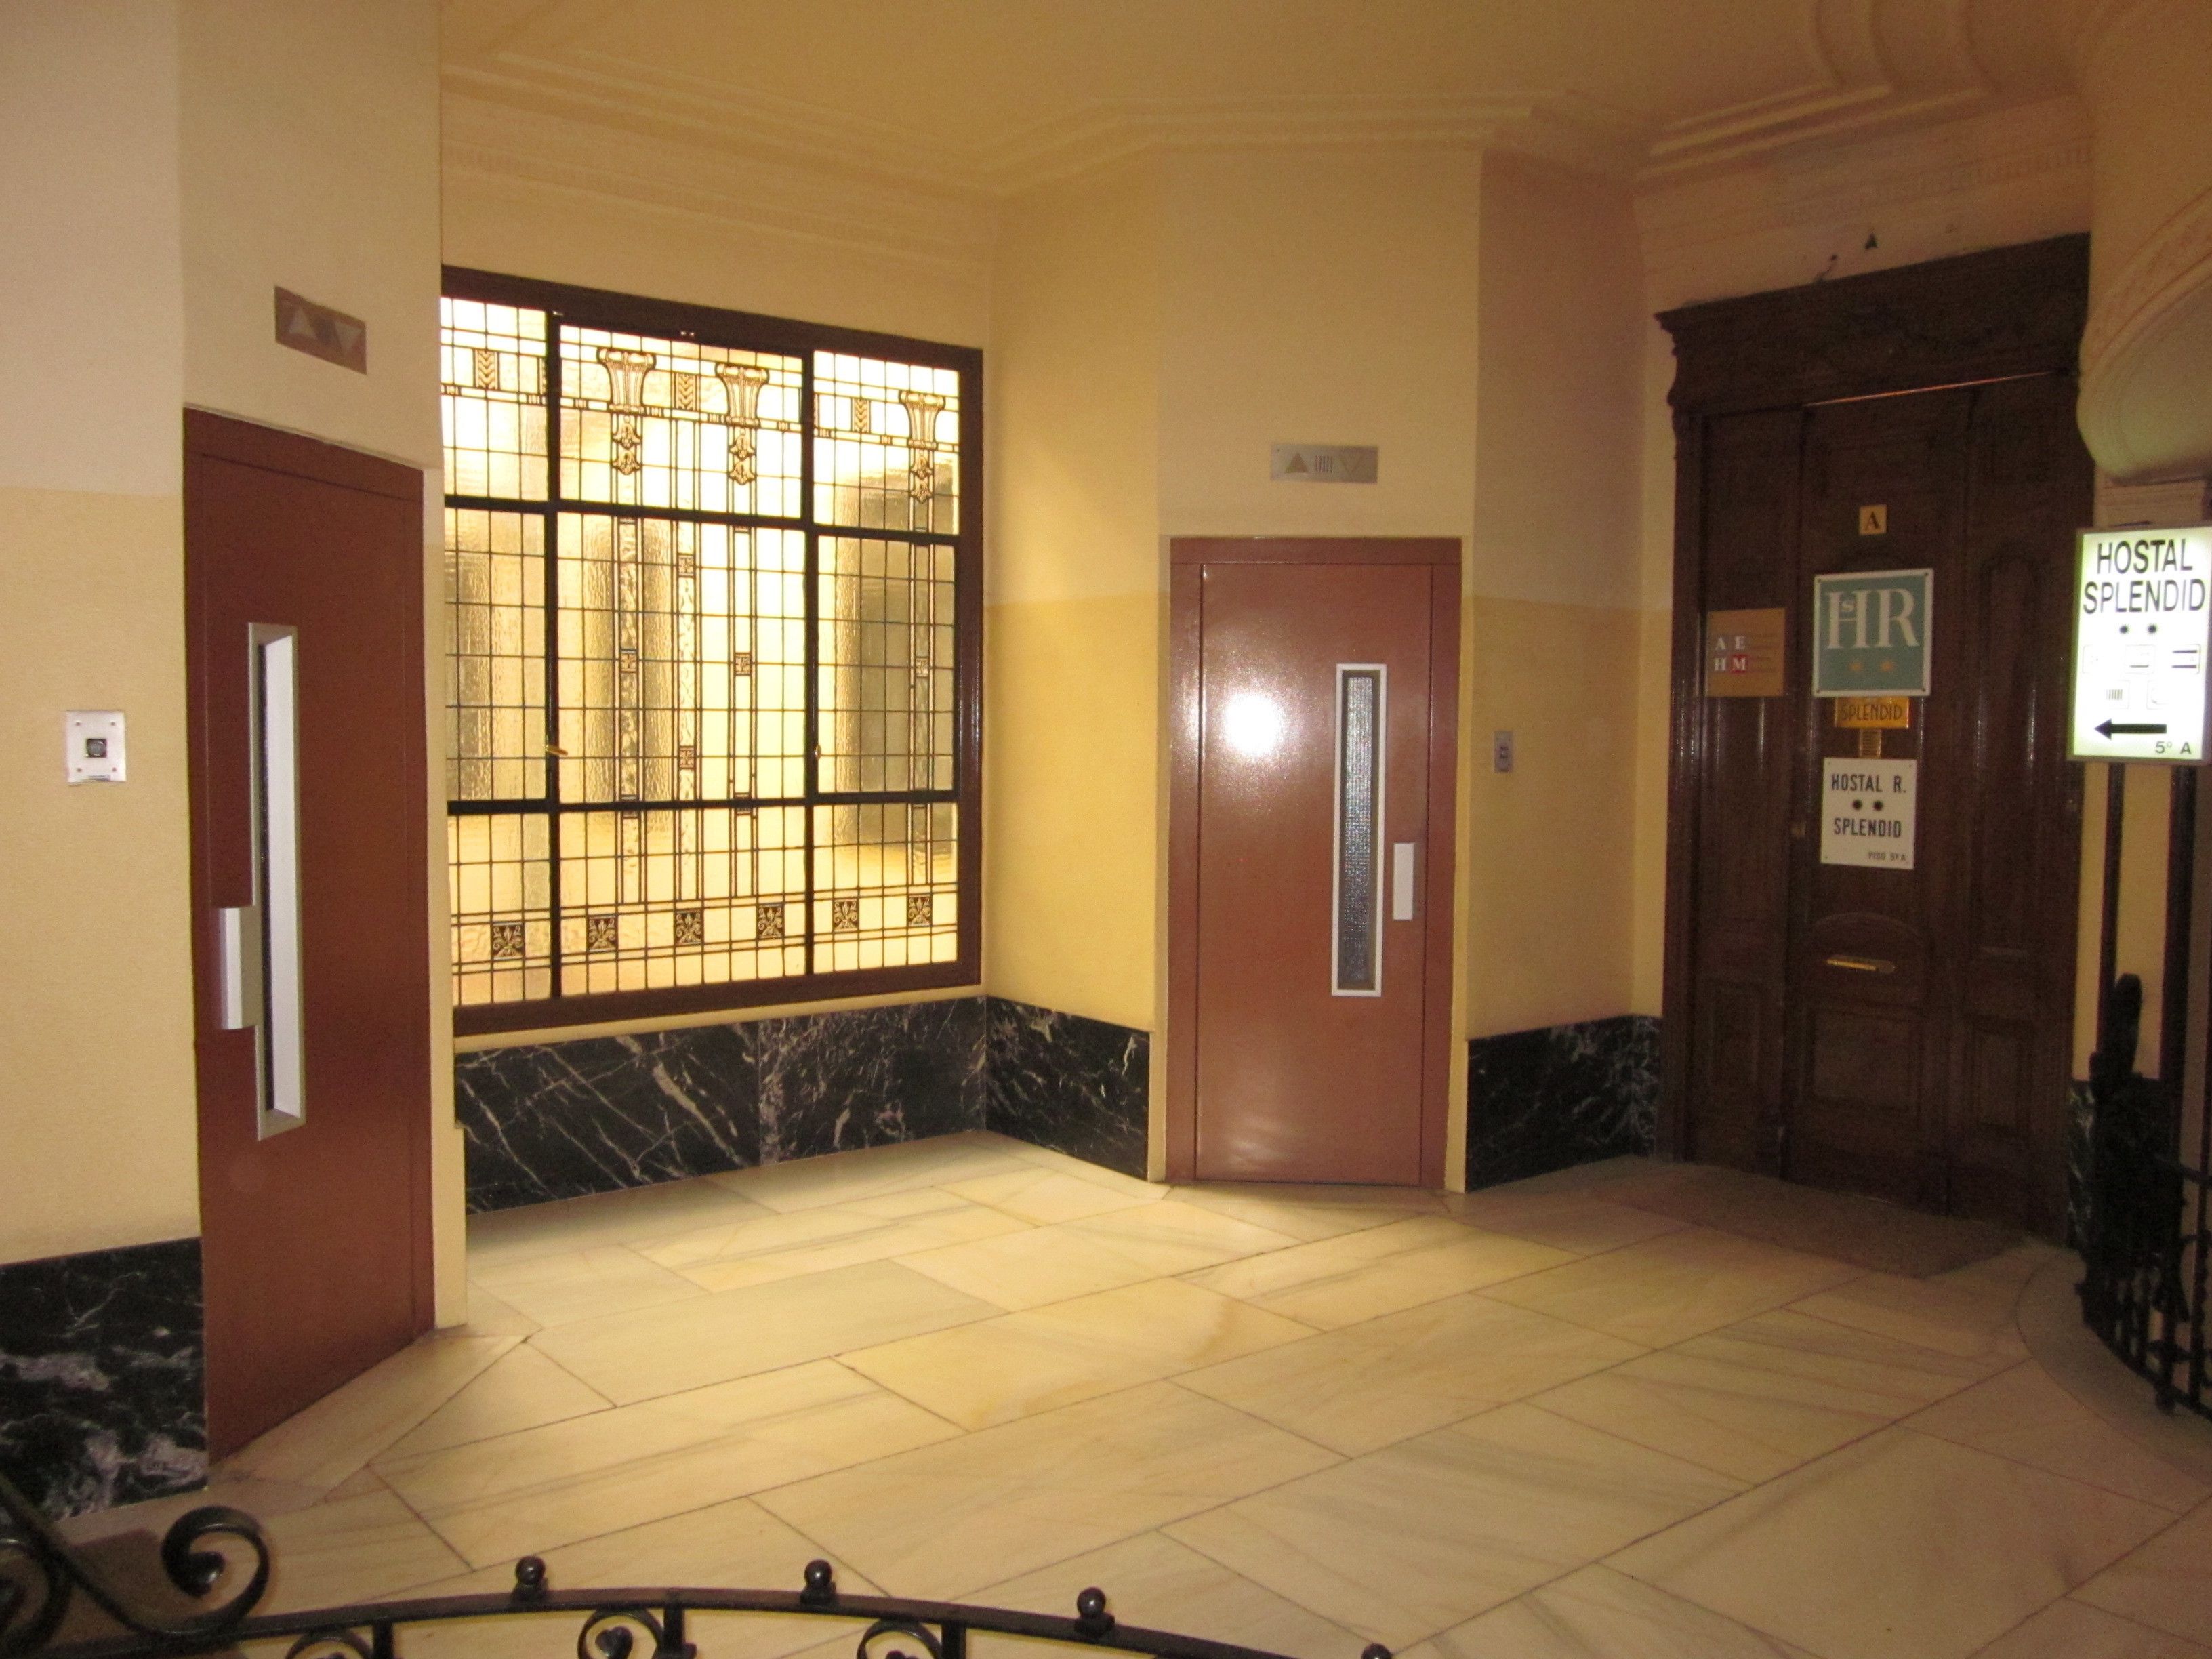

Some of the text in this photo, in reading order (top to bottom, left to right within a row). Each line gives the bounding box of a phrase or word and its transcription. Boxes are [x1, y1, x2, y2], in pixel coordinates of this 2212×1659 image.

[1865, 511, 1879, 531] A
[2097, 539, 2193, 574] HOSTAL
[2083, 579, 2206, 615] SPLENDID
[1841, 703, 1902, 721] SPLENDID
[1831, 773, 1906, 794] HOSTAL R.
[1834, 817, 1902, 838] SPLENDID
